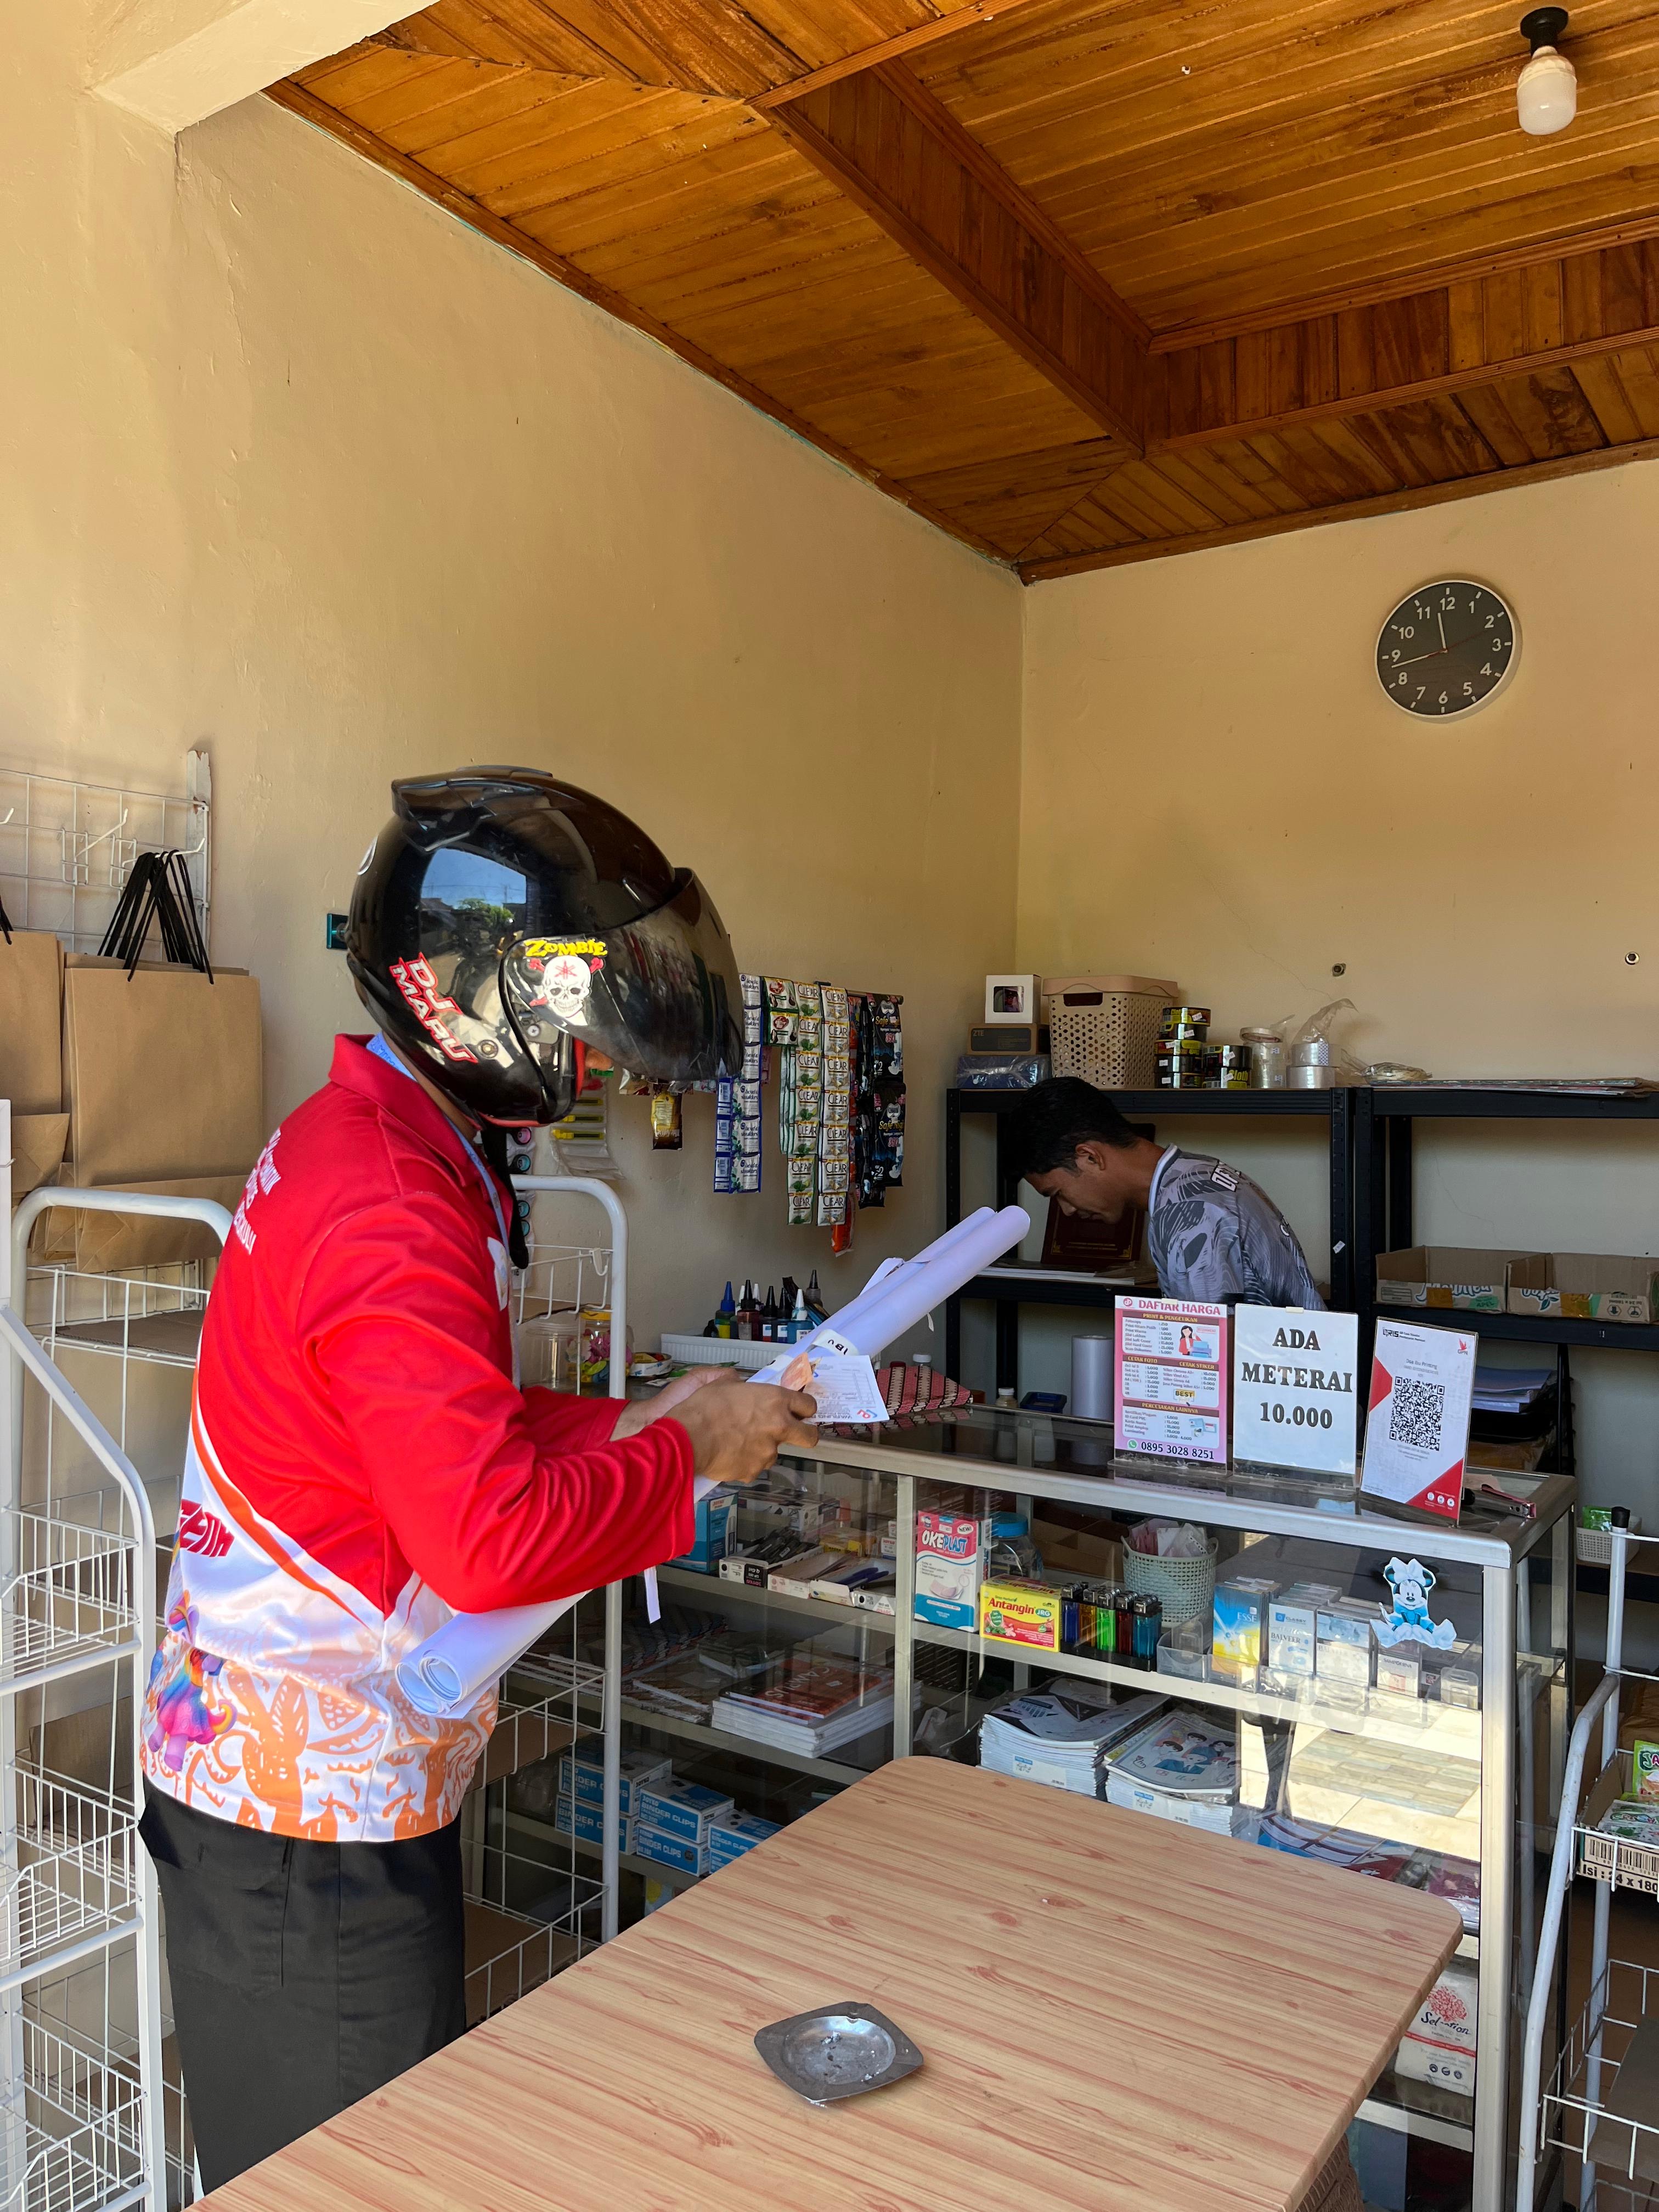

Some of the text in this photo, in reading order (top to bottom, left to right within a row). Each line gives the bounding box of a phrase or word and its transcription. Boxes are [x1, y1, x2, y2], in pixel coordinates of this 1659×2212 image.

[1440, 597, 1455, 611] 12
[1469, 601, 1475, 614] 1
[1417, 606, 1431, 620] 11
[1484, 615, 1494, 628] 2
[1399, 626, 1414, 640] 10
[1492, 638, 1502, 652] 3
[1391, 649, 1401, 662] 9
[1480, 662, 1492, 676] 4
[1398, 672, 1408, 685] 8
[1417, 686, 1426, 700] 7
[1463, 682, 1472, 696] 5
[1438, 691, 1448, 704] 6
[523, 939, 608, 957] ZOMBIE
[798, 984, 818, 997] CLEAR
[826, 990, 846, 1003] CLEAR
[799, 1019, 818, 1031] CLEA
[875, 1016, 889, 1026] Safe
[828, 1024, 848, 1036] CLEAR
[828, 1059, 847, 1070] CLEAR
[798, 1090, 819, 1101] CLEAR
[828, 1093, 847, 1105] CLEAR
[797, 1125, 817, 1136] CLEAR
[878, 1120, 892, 1130] Safe
[827, 1128, 847, 1139] CLEAR
[792, 1162, 812, 1173] CLEAR
[825, 1163, 847, 1174] CLEAR
[793, 1195, 811, 1207] CLEAR
[823, 1195, 844, 1207] CLEAR
[1138, 1300, 1221, 1315] DAFTAR HARGA
[1272, 1327, 1321, 1351] ADA
[1383, 1329, 1399, 1338] QRIS
[1241, 1362, 1353, 1393] METERAI
[1142, 1403, 1175, 1411] PERCETAKAN
[1260, 1402, 1332, 1429] 10.000
[1141, 1442, 1214, 1459] 0895 3028 8251
[922, 1530, 968, 1554] OKEPLAST
[988, 1598, 1034, 1615] Antangin
[1237, 1611, 1257, 1623] ESSE
[1271, 1632, 1301, 1644] BALVEER
[764, 1666, 831, 1699] CAMPUS
[641, 1802, 696, 1828] BINDER CLIPS
[639, 1836, 662, 1850] BINDER
[663, 1845, 681, 1858] CLIPS
[1583, 1864, 1598, 1877] Isi
[1638, 1879, 1658, 1893] 180
[1421, 2012, 1471, 2035] Seltion
